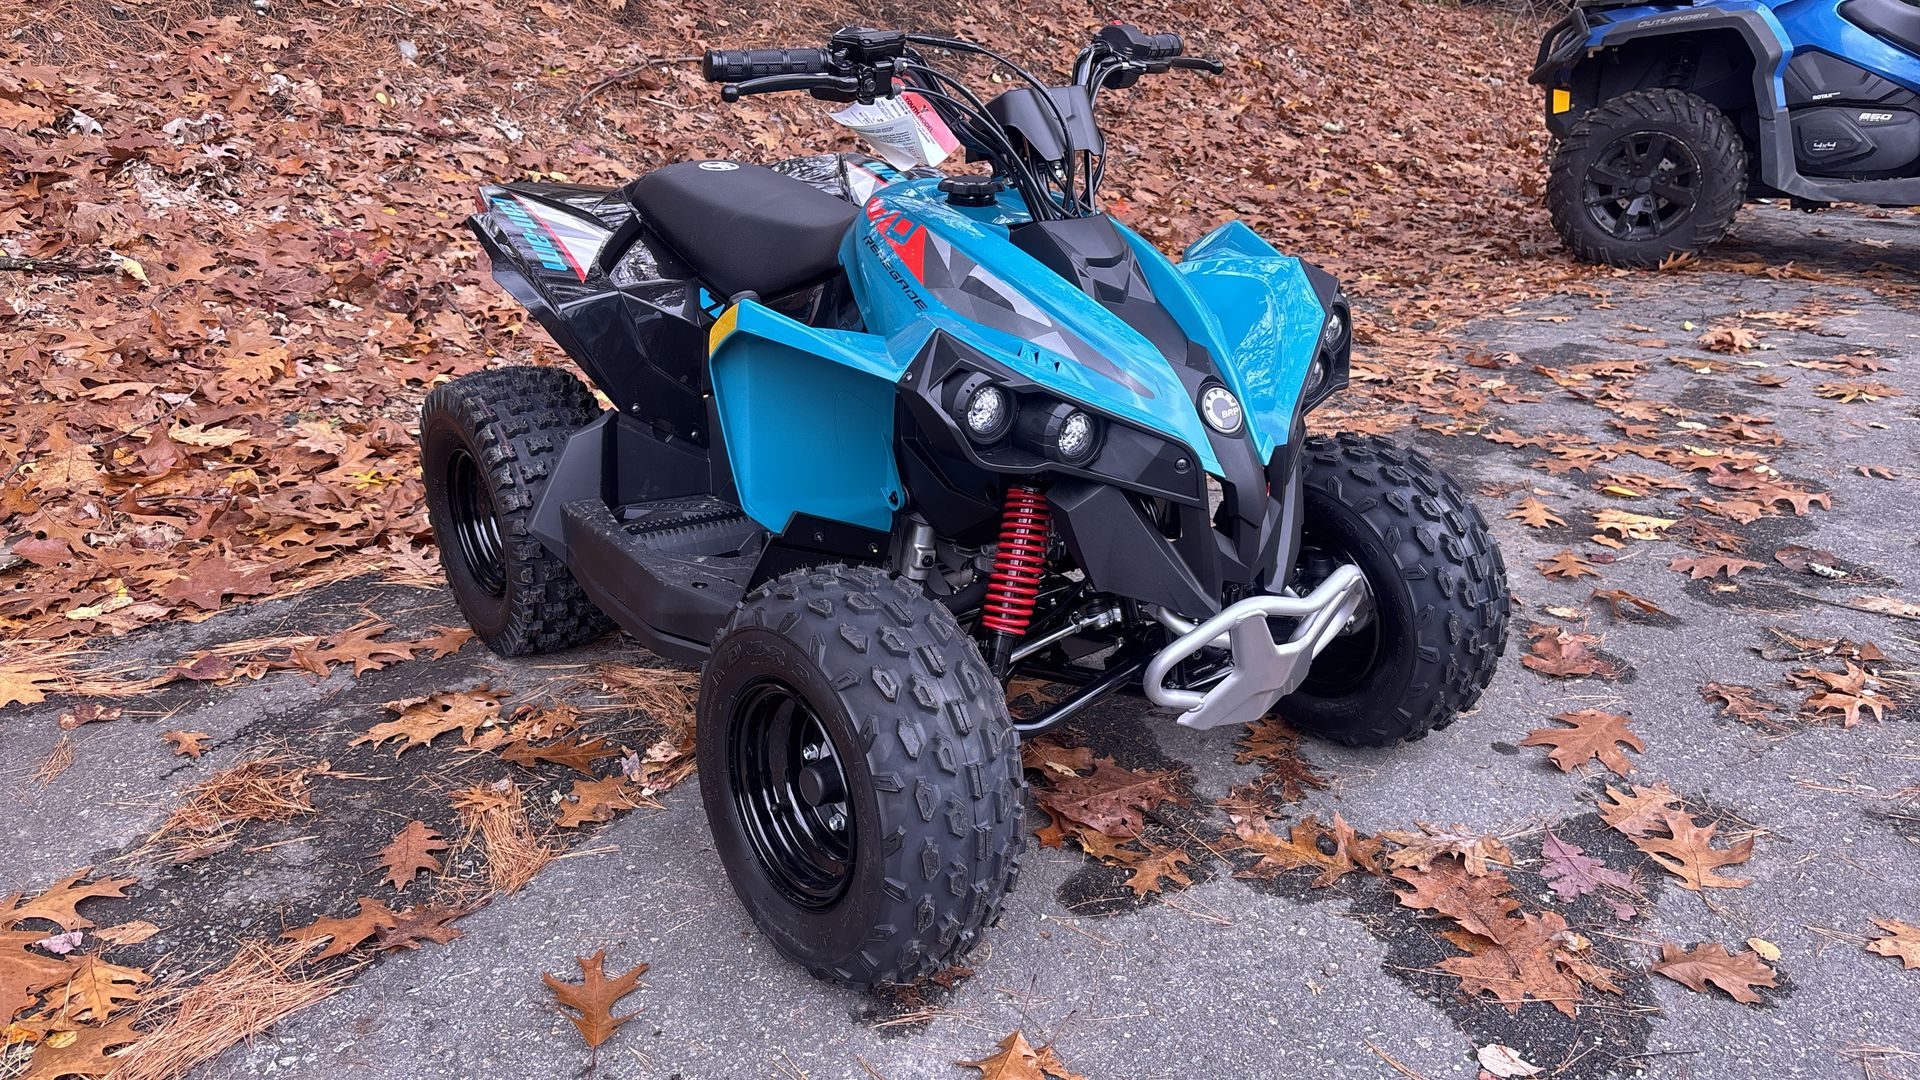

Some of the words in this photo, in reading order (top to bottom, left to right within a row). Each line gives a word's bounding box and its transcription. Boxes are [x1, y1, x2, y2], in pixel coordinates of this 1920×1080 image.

[1637, 12, 1710, 28] OUTLANDER
[904, 96, 920, 116] YOUTH
[918, 115, 934, 133] MODEL
[863, 235, 928, 311] RENEGADE
[1223, 407, 1238, 418] BRP
